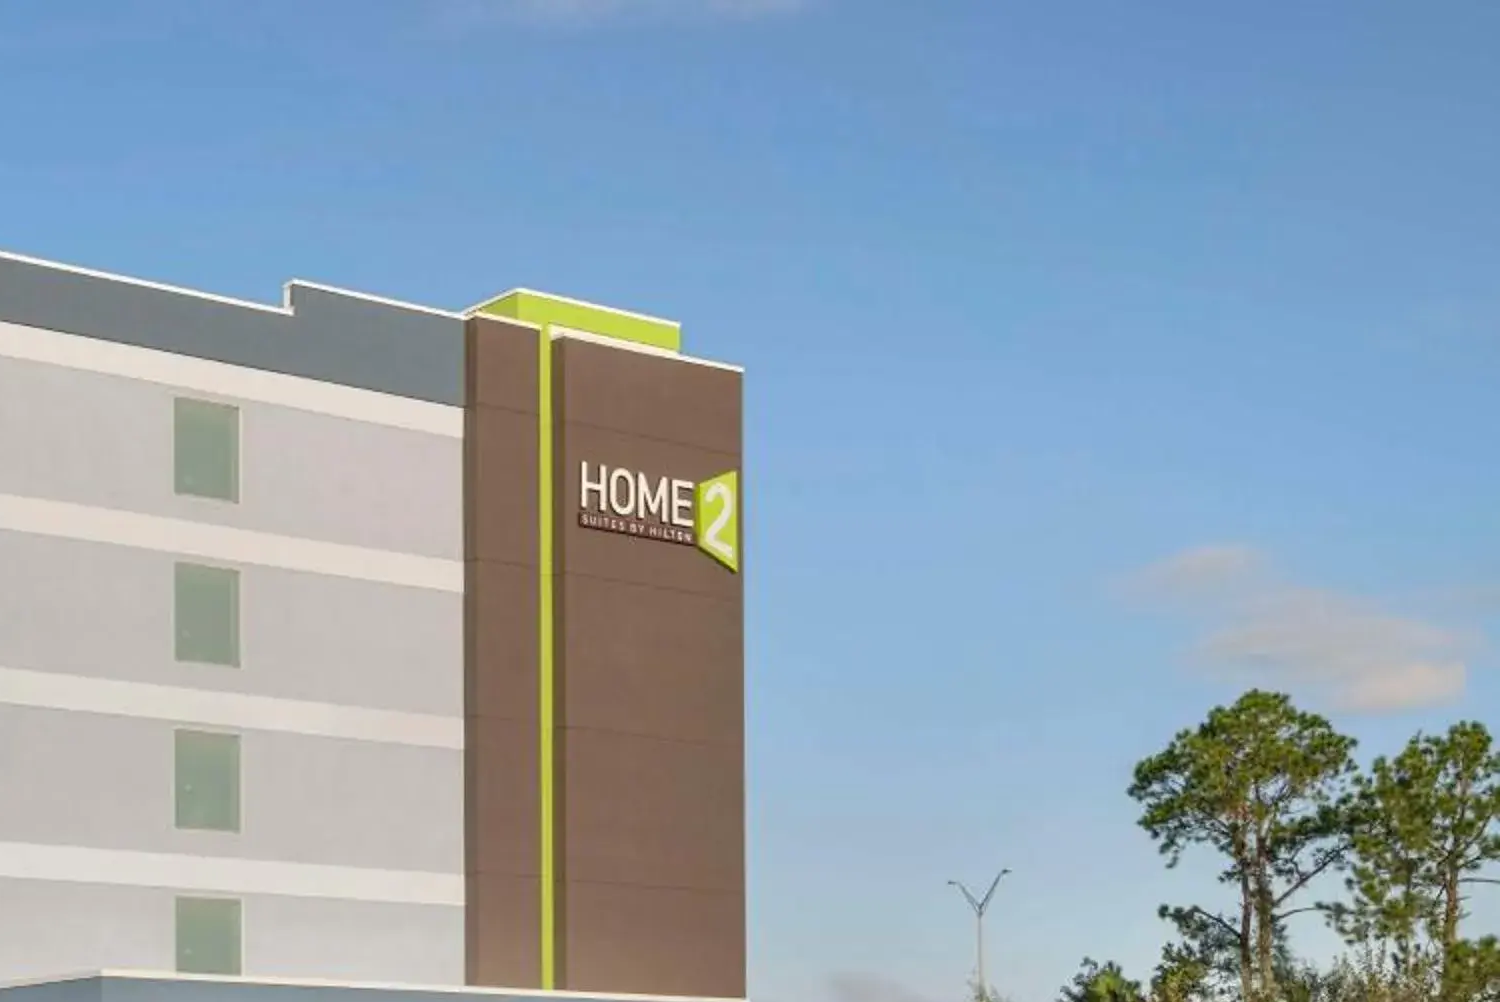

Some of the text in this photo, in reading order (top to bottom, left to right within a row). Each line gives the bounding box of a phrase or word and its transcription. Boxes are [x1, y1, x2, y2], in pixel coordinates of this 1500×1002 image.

[580, 460, 734, 559] HOME 2
[580, 513, 694, 543] SUITES BY HILTON
